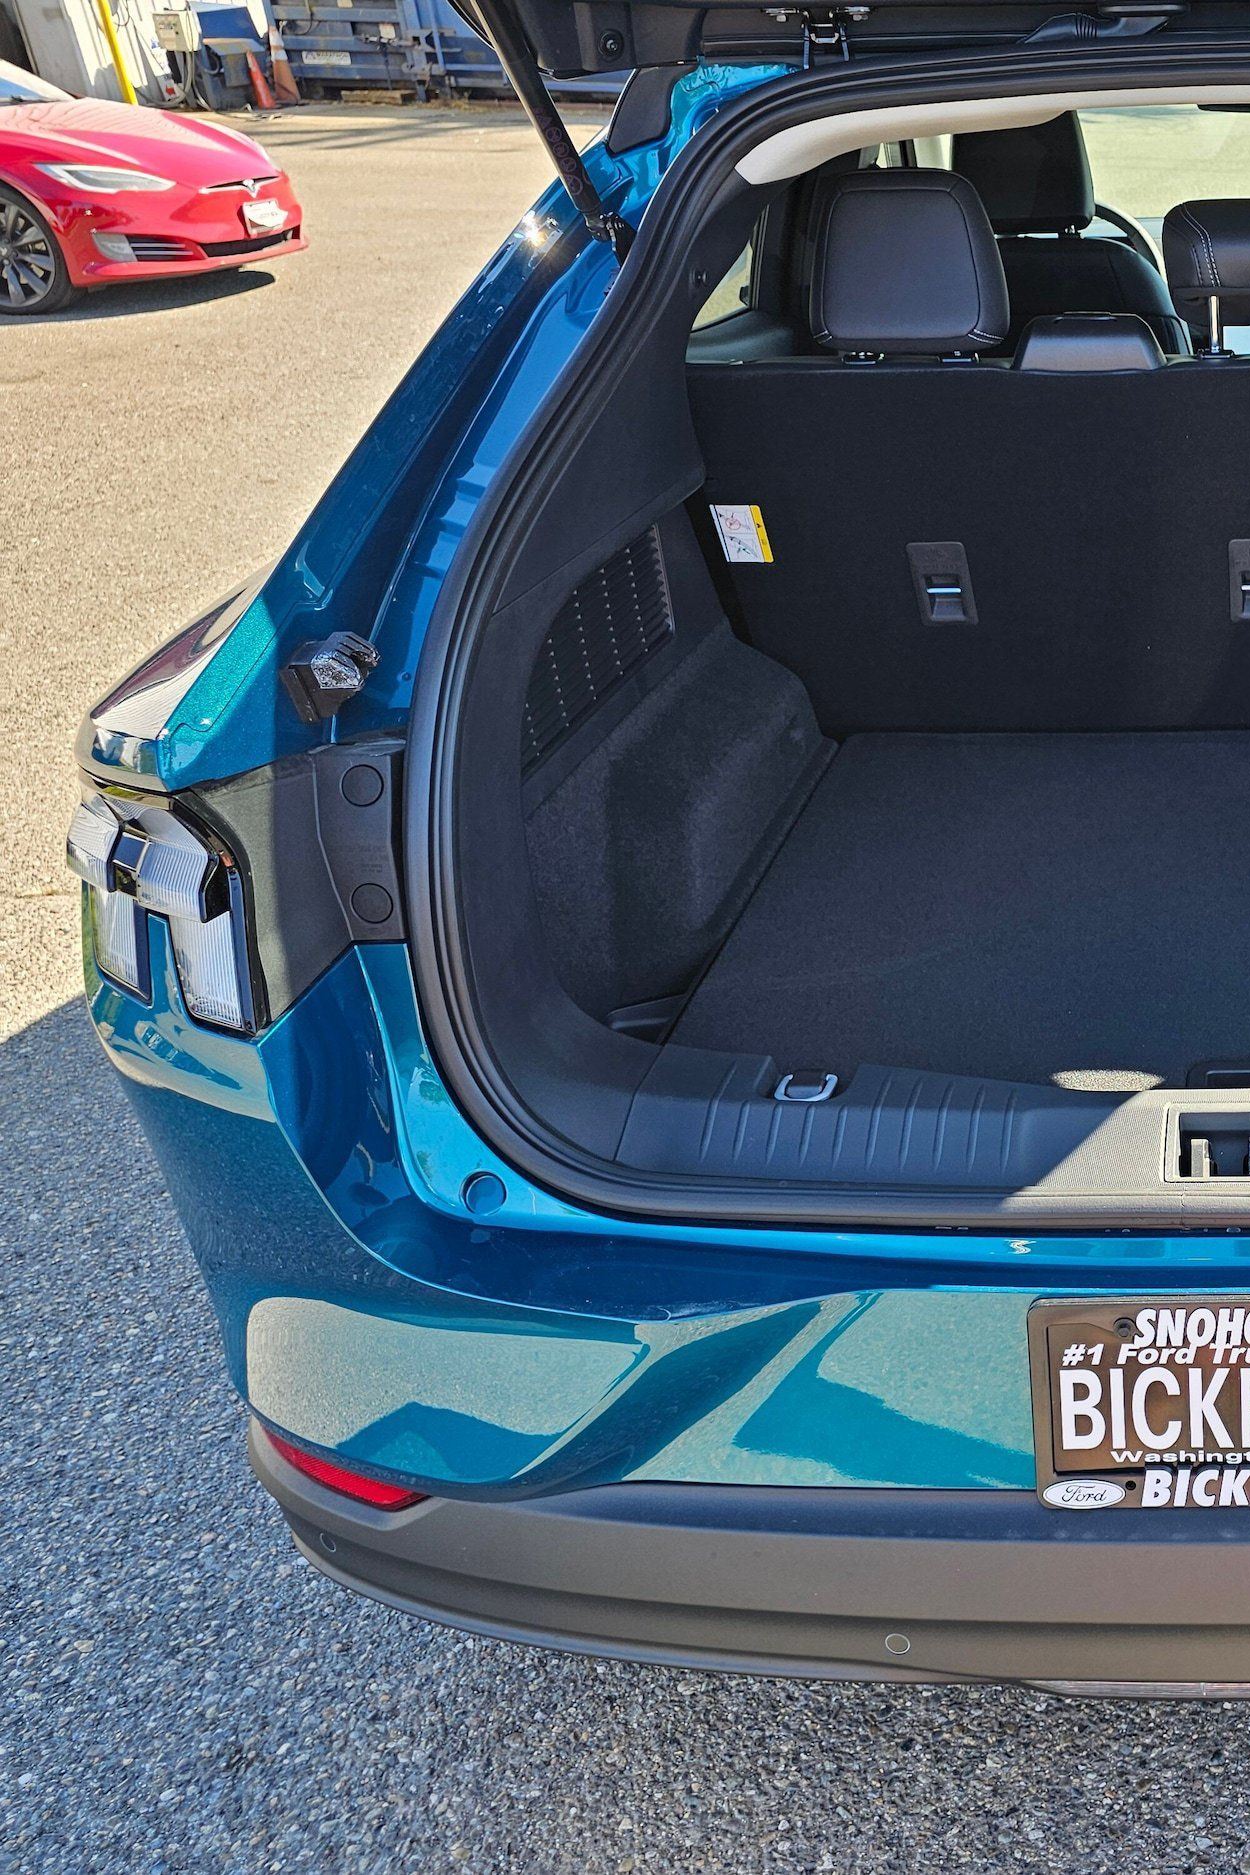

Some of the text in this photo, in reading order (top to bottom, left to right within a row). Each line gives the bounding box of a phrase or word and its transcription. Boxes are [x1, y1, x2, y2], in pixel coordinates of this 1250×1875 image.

[1062, 1343, 1104, 1366] #1
[1116, 1343, 1197, 1365] Ford
[1061, 1484, 1107, 1503] Ford
